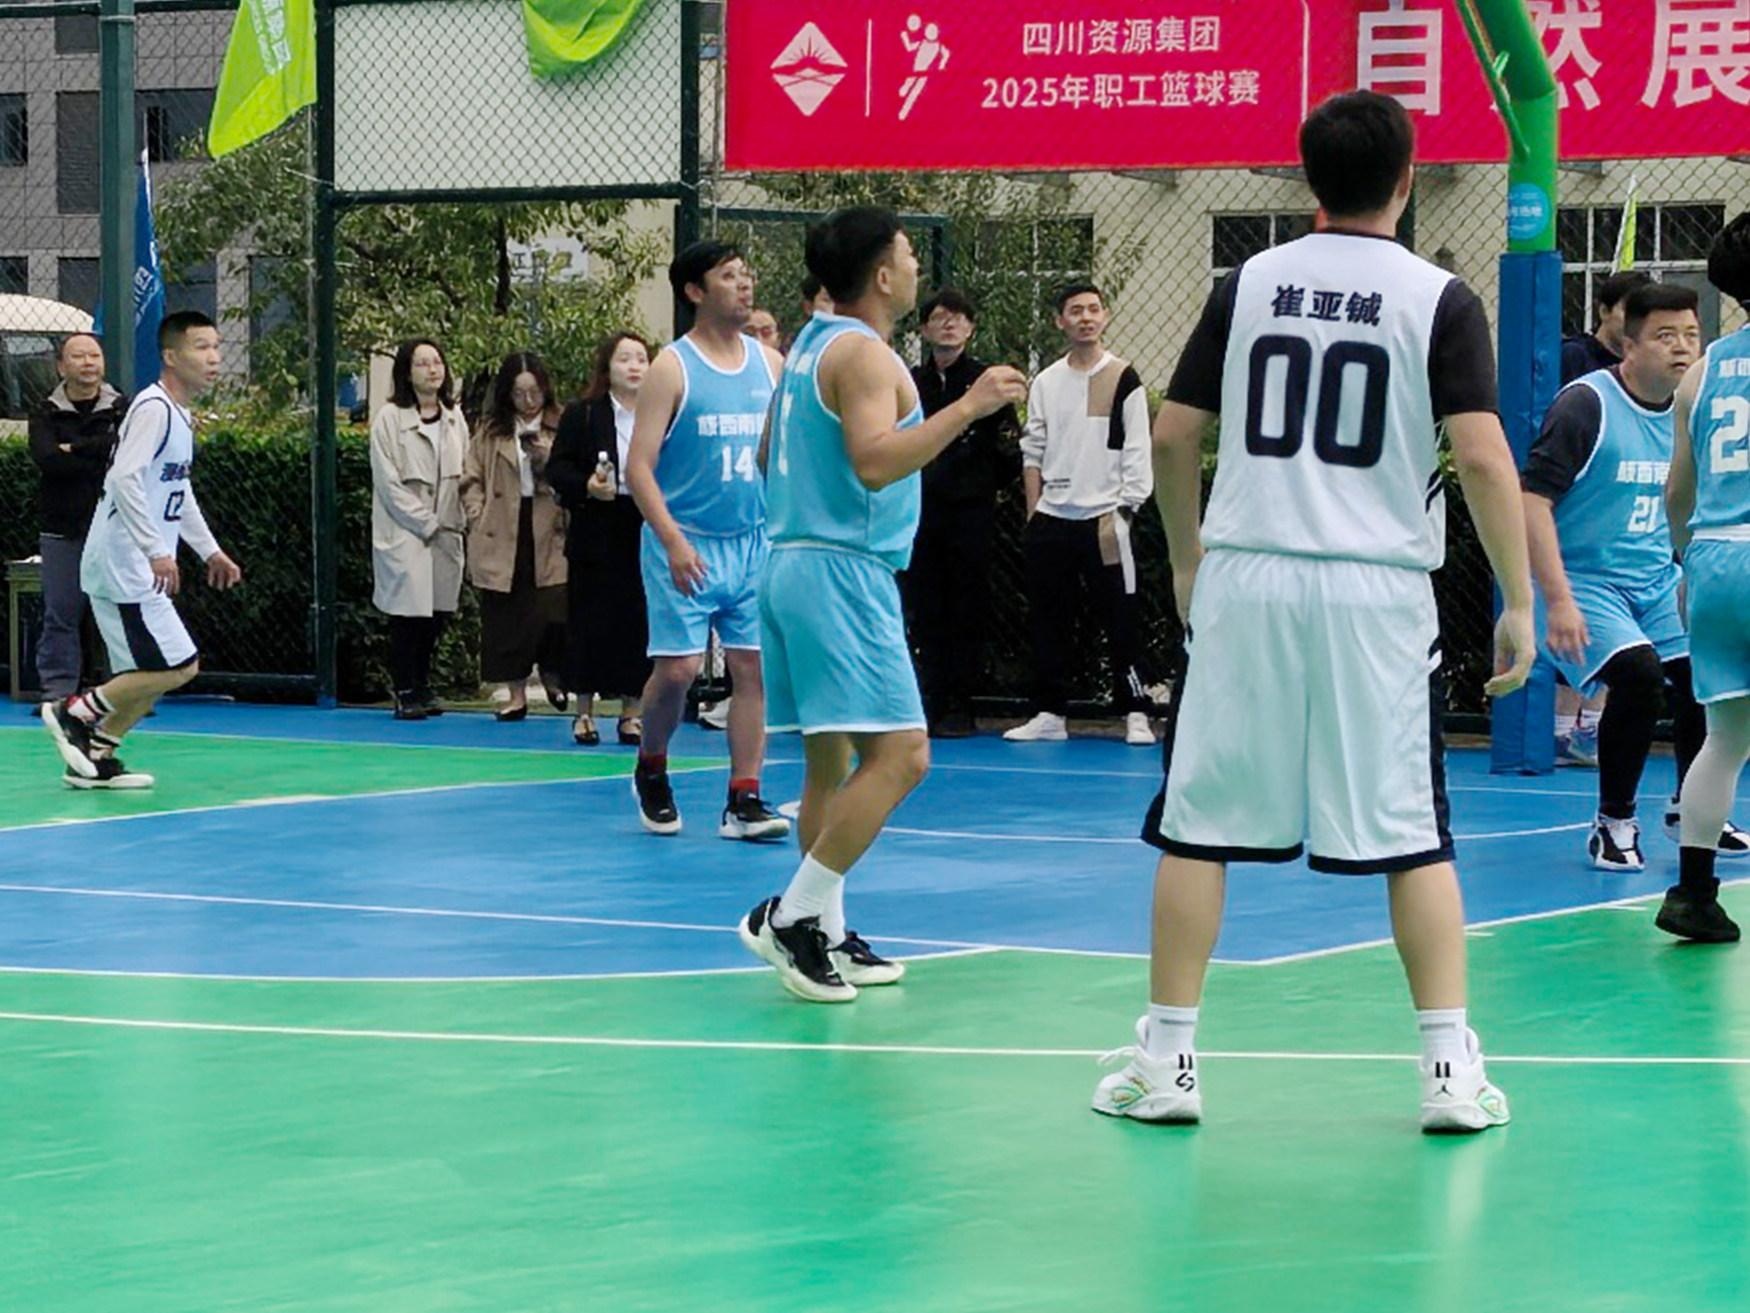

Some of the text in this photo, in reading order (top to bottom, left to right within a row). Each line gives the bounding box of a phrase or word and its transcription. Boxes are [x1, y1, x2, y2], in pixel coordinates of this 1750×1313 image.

[1023, 16, 1220, 56] 四川资源集团
[981, 70, 1261, 109] 2025年职工篮球赛
[1245, 334, 1391, 468] 00
[721, 445, 754, 483] 14
[1627, 495, 1660, 533] 21
